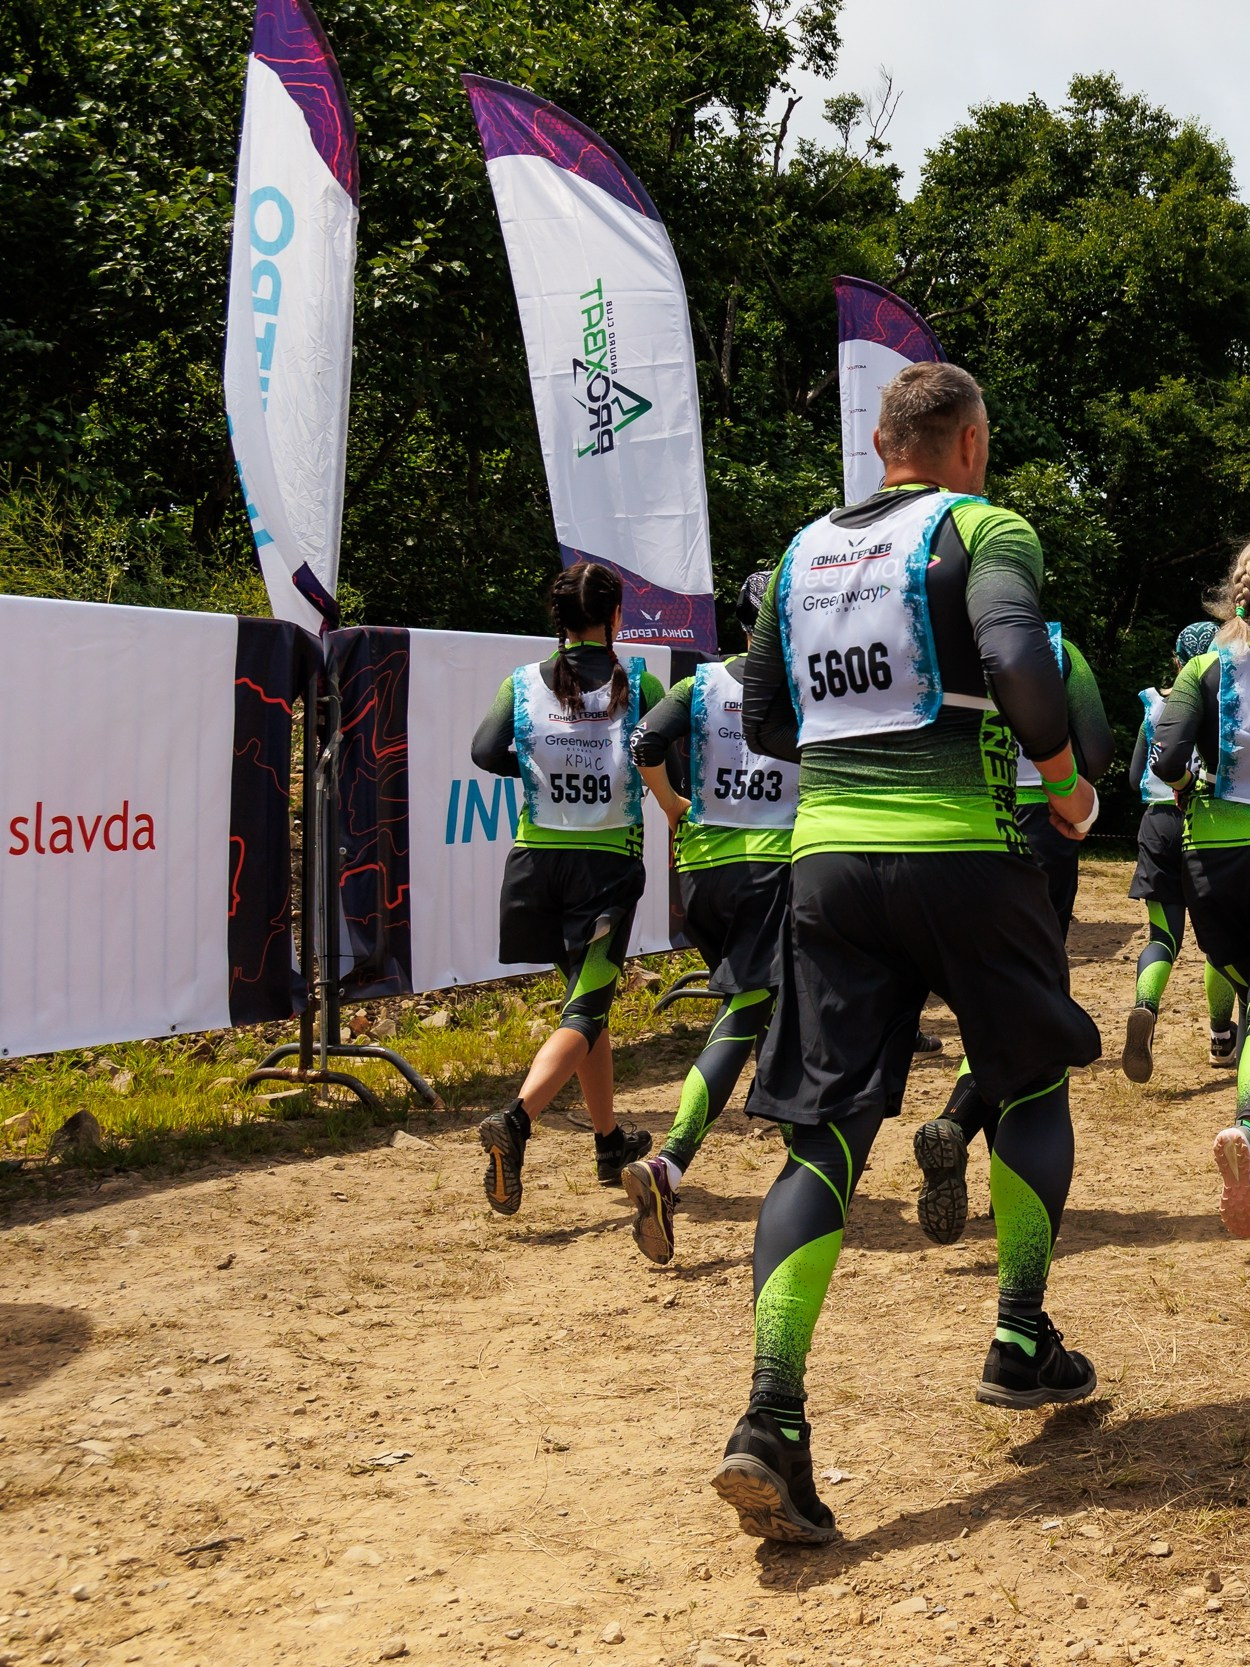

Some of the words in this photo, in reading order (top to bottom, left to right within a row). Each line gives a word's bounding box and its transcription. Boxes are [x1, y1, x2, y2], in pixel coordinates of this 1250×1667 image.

[811, 553, 847, 567] ГОНКА
[850, 542, 893, 562] ГЕРОЕВ
[803, 586, 881, 611] Greenway
[808, 641, 893, 702] 5606
[549, 713, 577, 722] ГОНКА
[724, 701, 742, 709] ГОН
[545, 734, 605, 750] Greenway
[565, 753, 605, 771] КРИС
[550, 773, 612, 805] 5599
[714, 767, 783, 802] 5583
[8, 799, 156, 856] slavda
